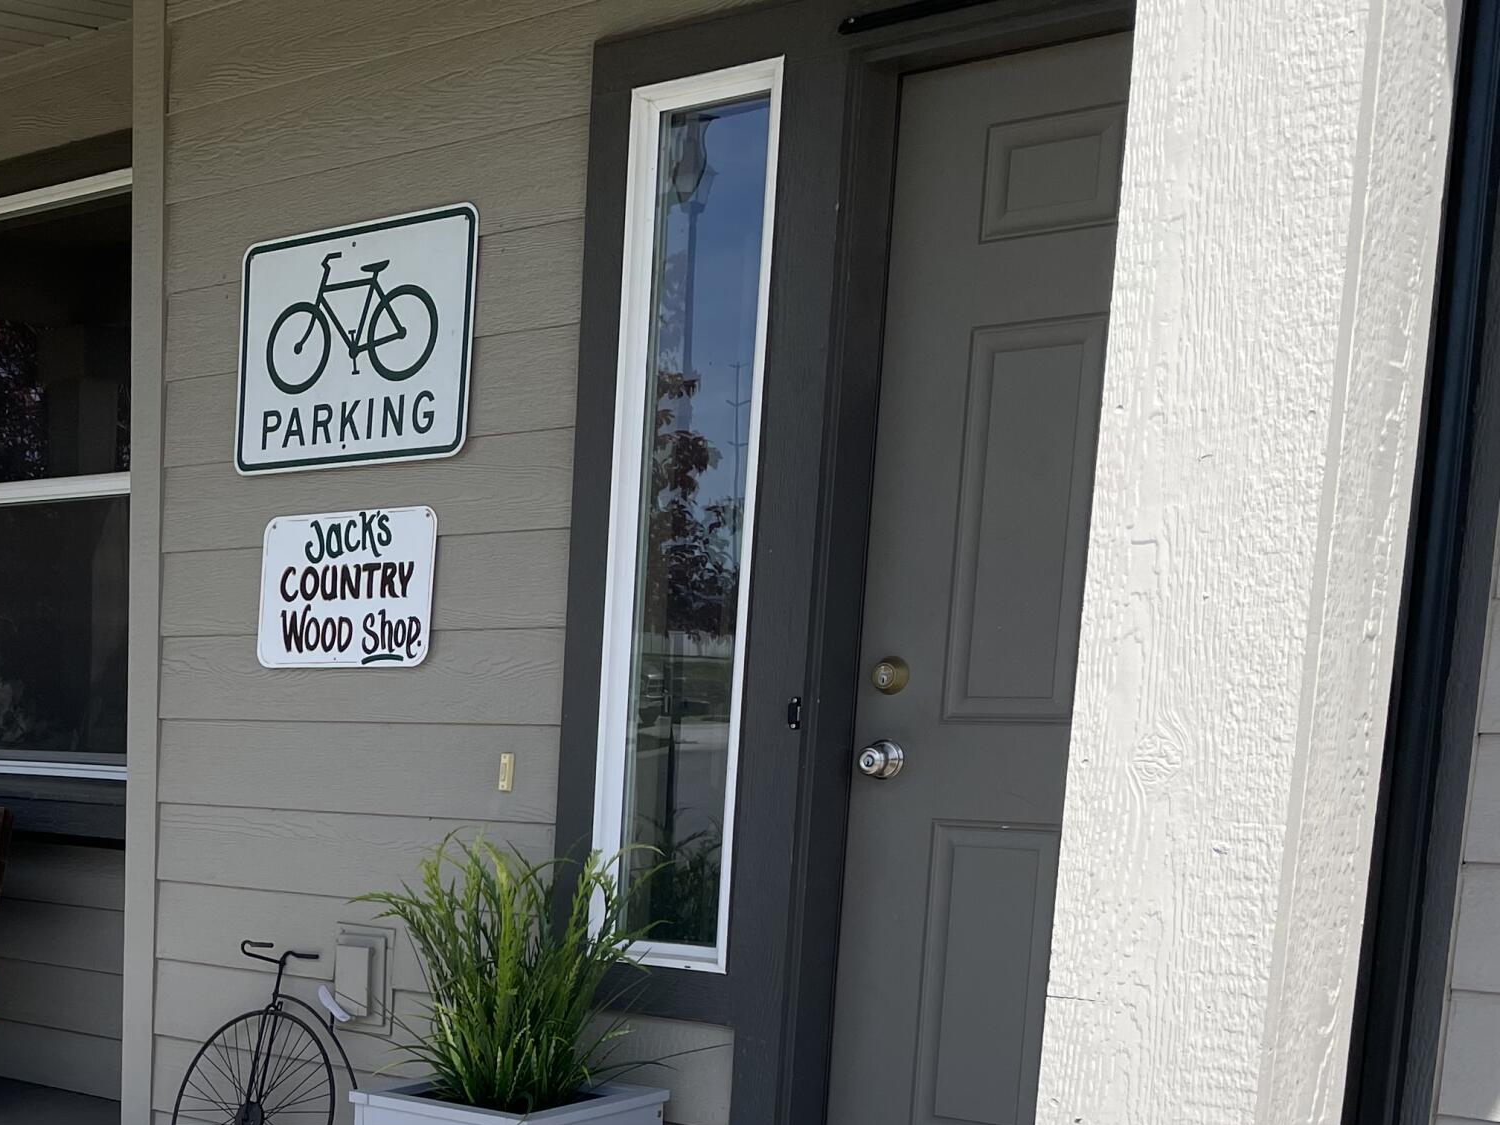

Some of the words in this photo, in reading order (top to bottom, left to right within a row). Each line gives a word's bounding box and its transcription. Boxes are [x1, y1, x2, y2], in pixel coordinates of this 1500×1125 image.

[261, 390, 435, 450] PARKING
[304, 510, 392, 564] Jack's
[280, 561, 415, 603] COUNTRY
